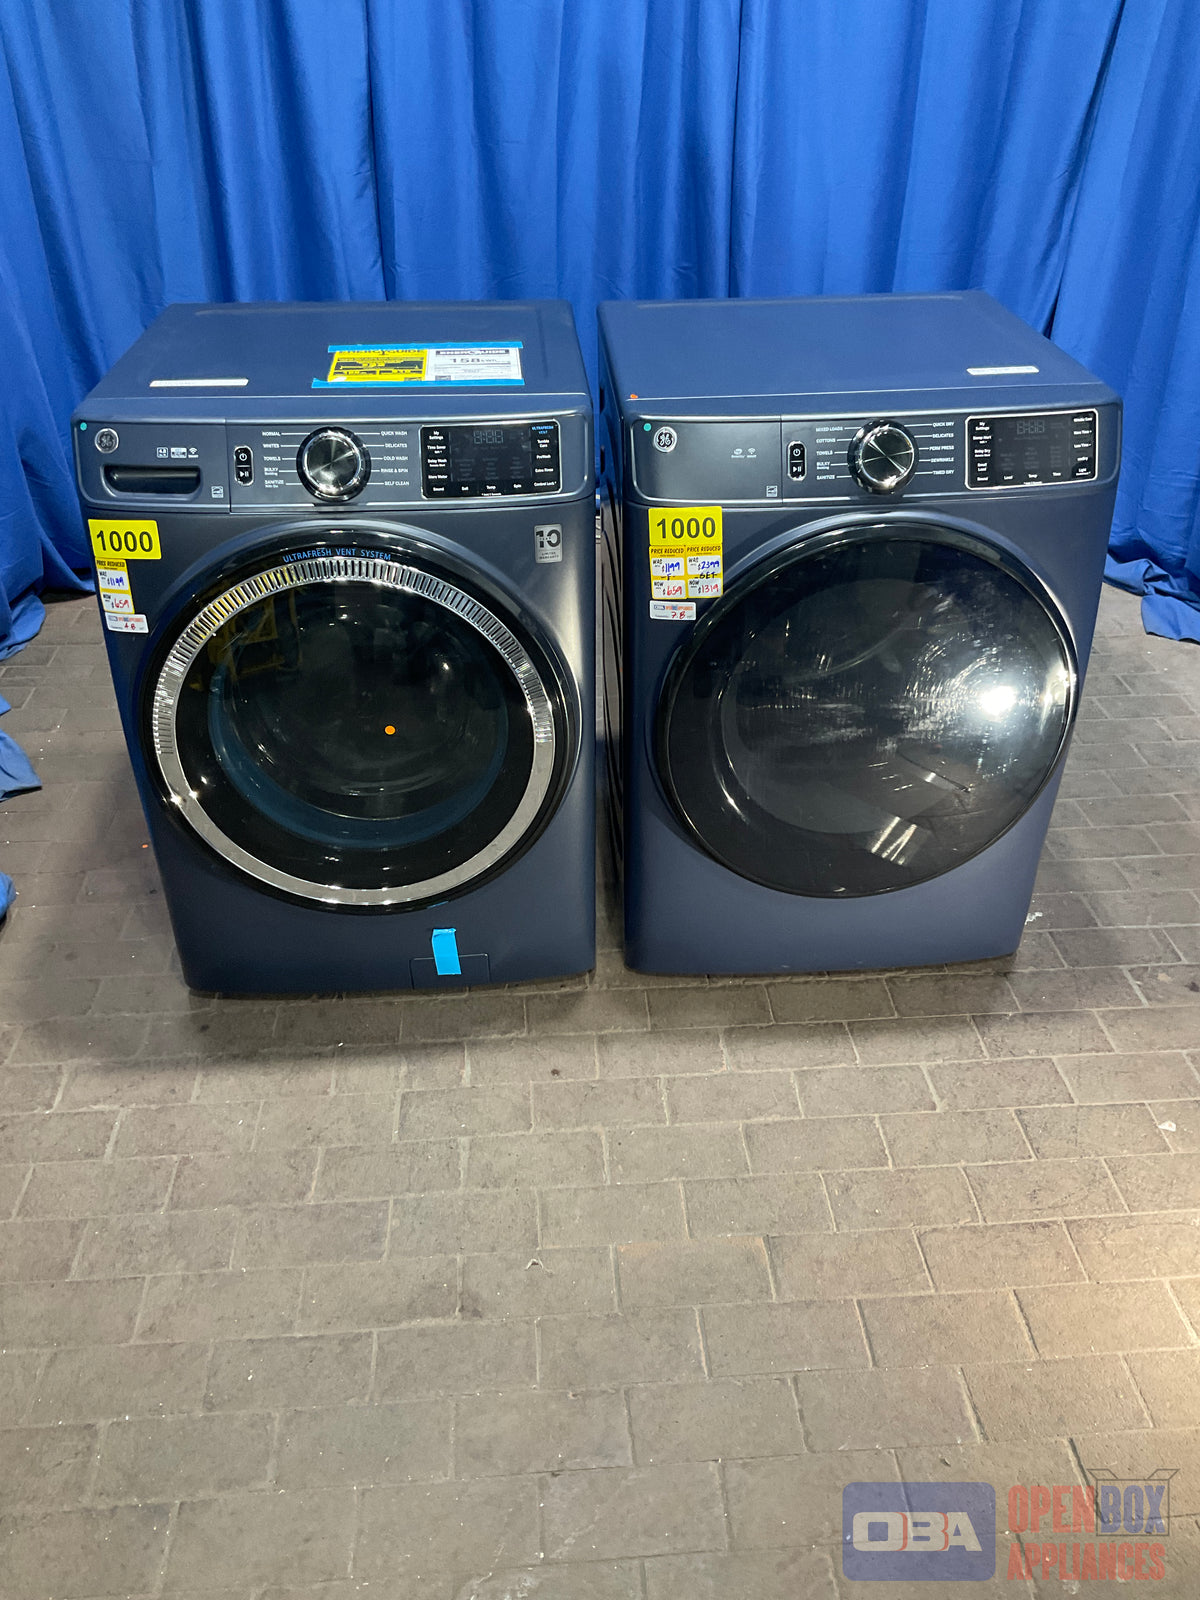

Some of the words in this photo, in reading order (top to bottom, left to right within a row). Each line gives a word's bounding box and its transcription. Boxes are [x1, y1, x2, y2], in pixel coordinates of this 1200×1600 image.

[657, 517, 716, 539] 1000
[96, 530, 154, 552] 1000
[535, 529, 561, 549] 10
[282, 547, 332, 563] ULTRAFRESH
[335, 548, 356, 556] VENT
[360, 549, 392, 561] SYSTEM
